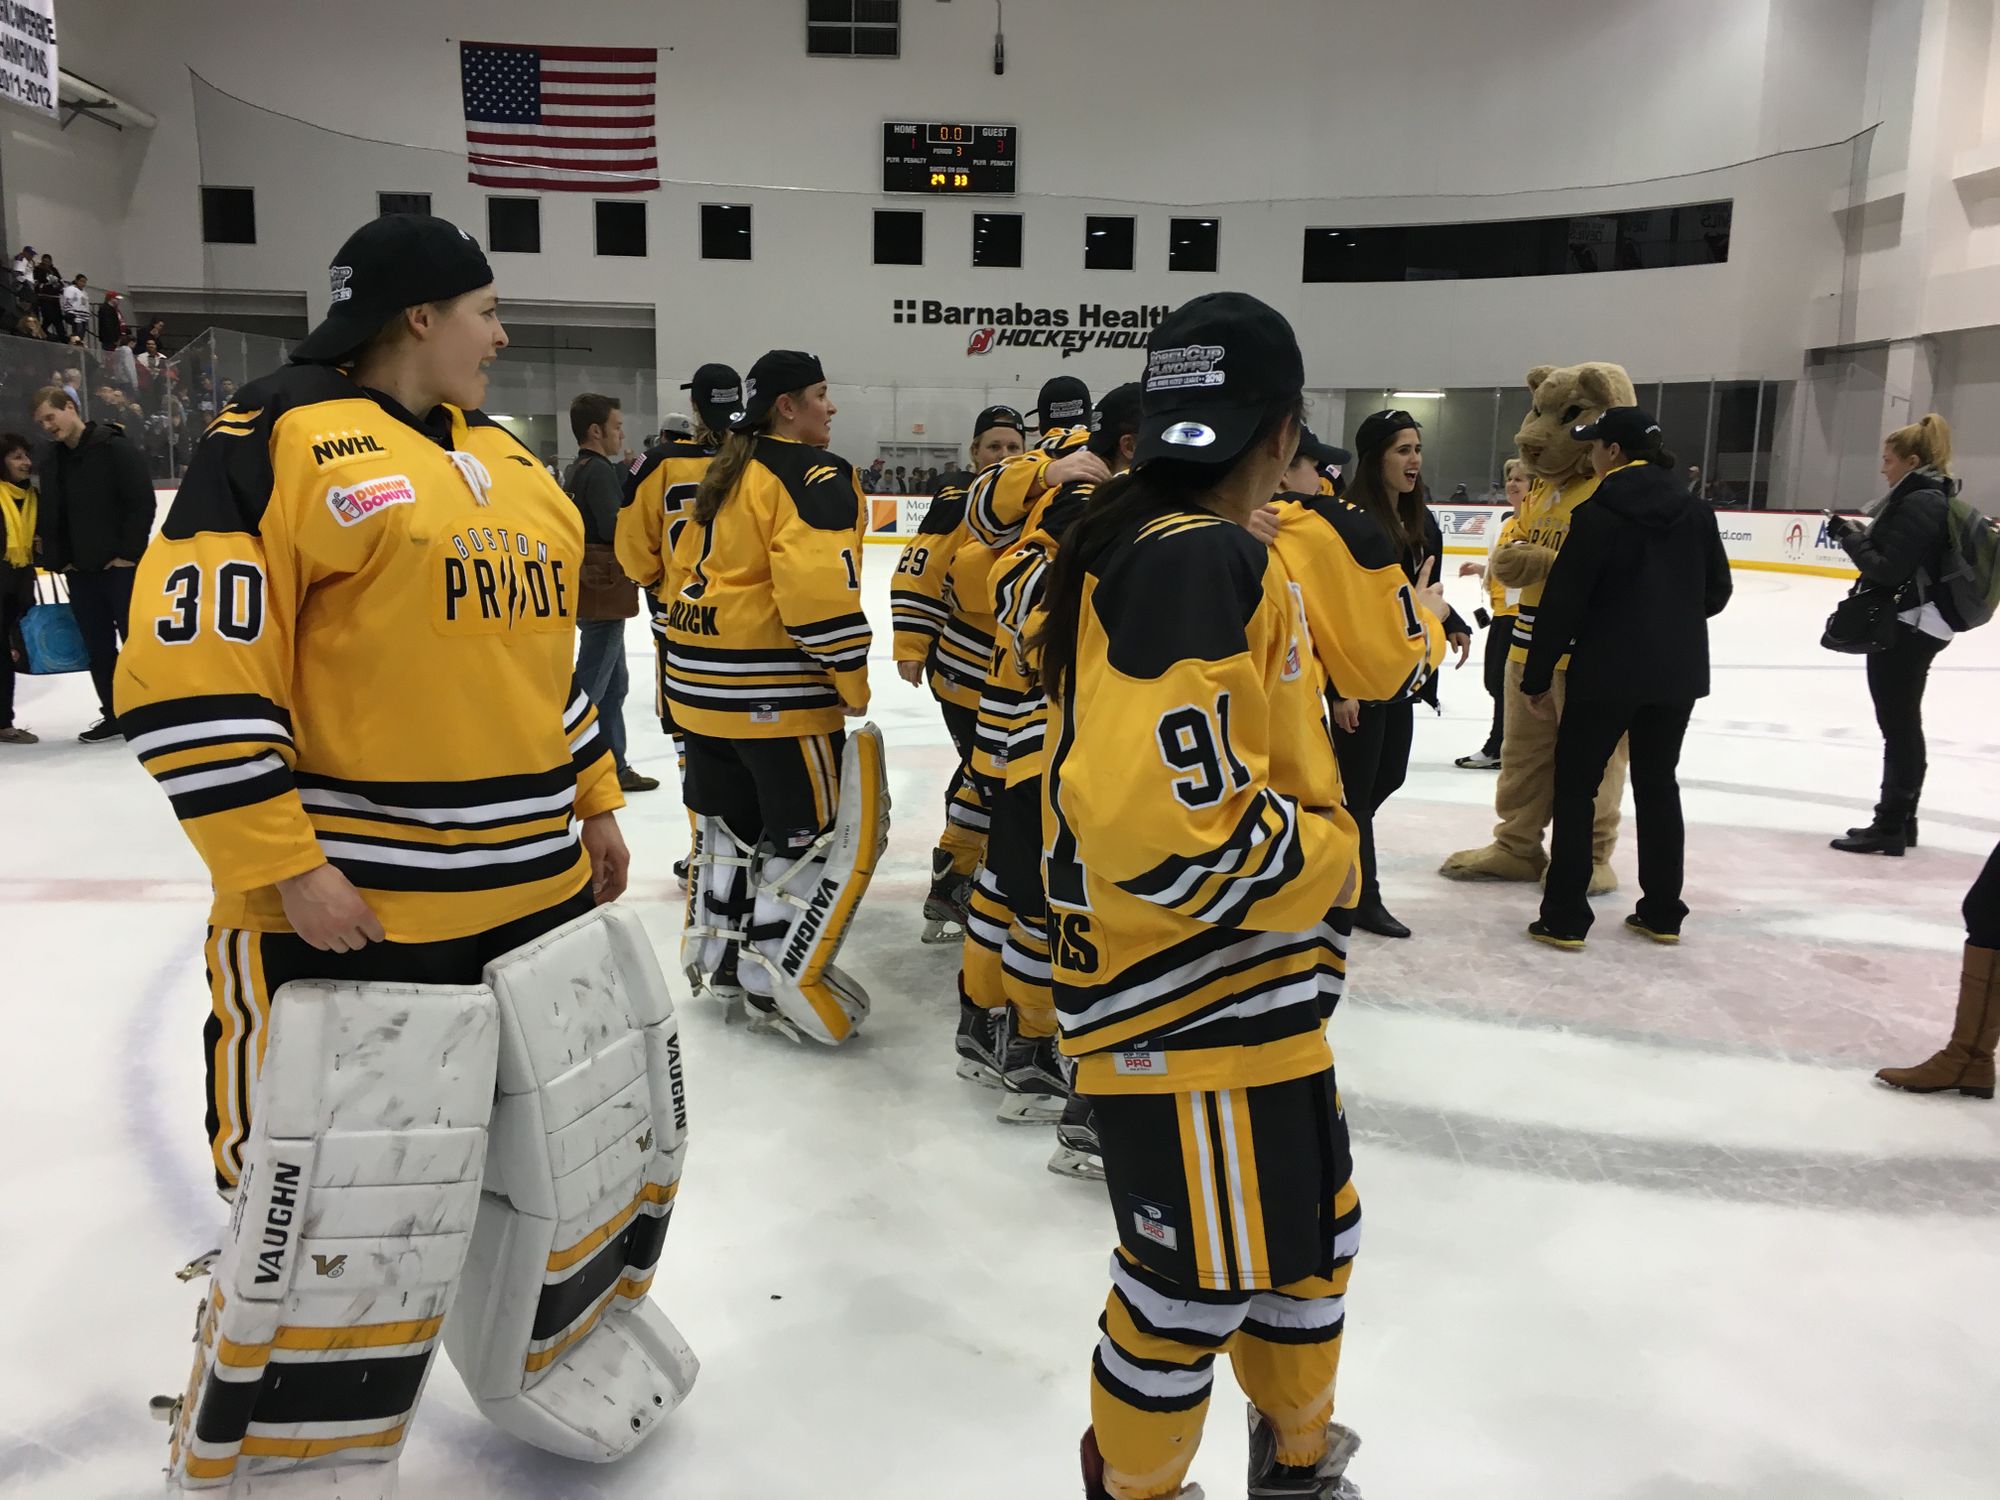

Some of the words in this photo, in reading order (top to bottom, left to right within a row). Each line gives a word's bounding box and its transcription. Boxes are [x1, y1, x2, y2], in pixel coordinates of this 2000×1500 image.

[894, 125, 917, 134] HOME
[982, 127, 1008, 137] GUEST
[956, 146, 962, 157] 3
[996, 140, 1005, 153] 3
[930, 173, 945, 186] 29
[954, 174, 968, 187] 33
[922, 300, 1069, 327] Barnabas
[996, 329, 1097, 358] HOCKEY
[312, 435, 387, 465] NWHL
[452, 527, 548, 565] BOSTON
[897, 545, 930, 578] 29
[155, 559, 266, 646] 30
[1396, 584, 1423, 639] 1
[1156, 690, 1252, 811] 91
[781, 877, 840, 979] VAUGHN
[1125, 1058, 1153, 1068] PRO
[666, 1031, 688, 1131] VAUGHN
[254, 1161, 302, 1285] VAUGHN
